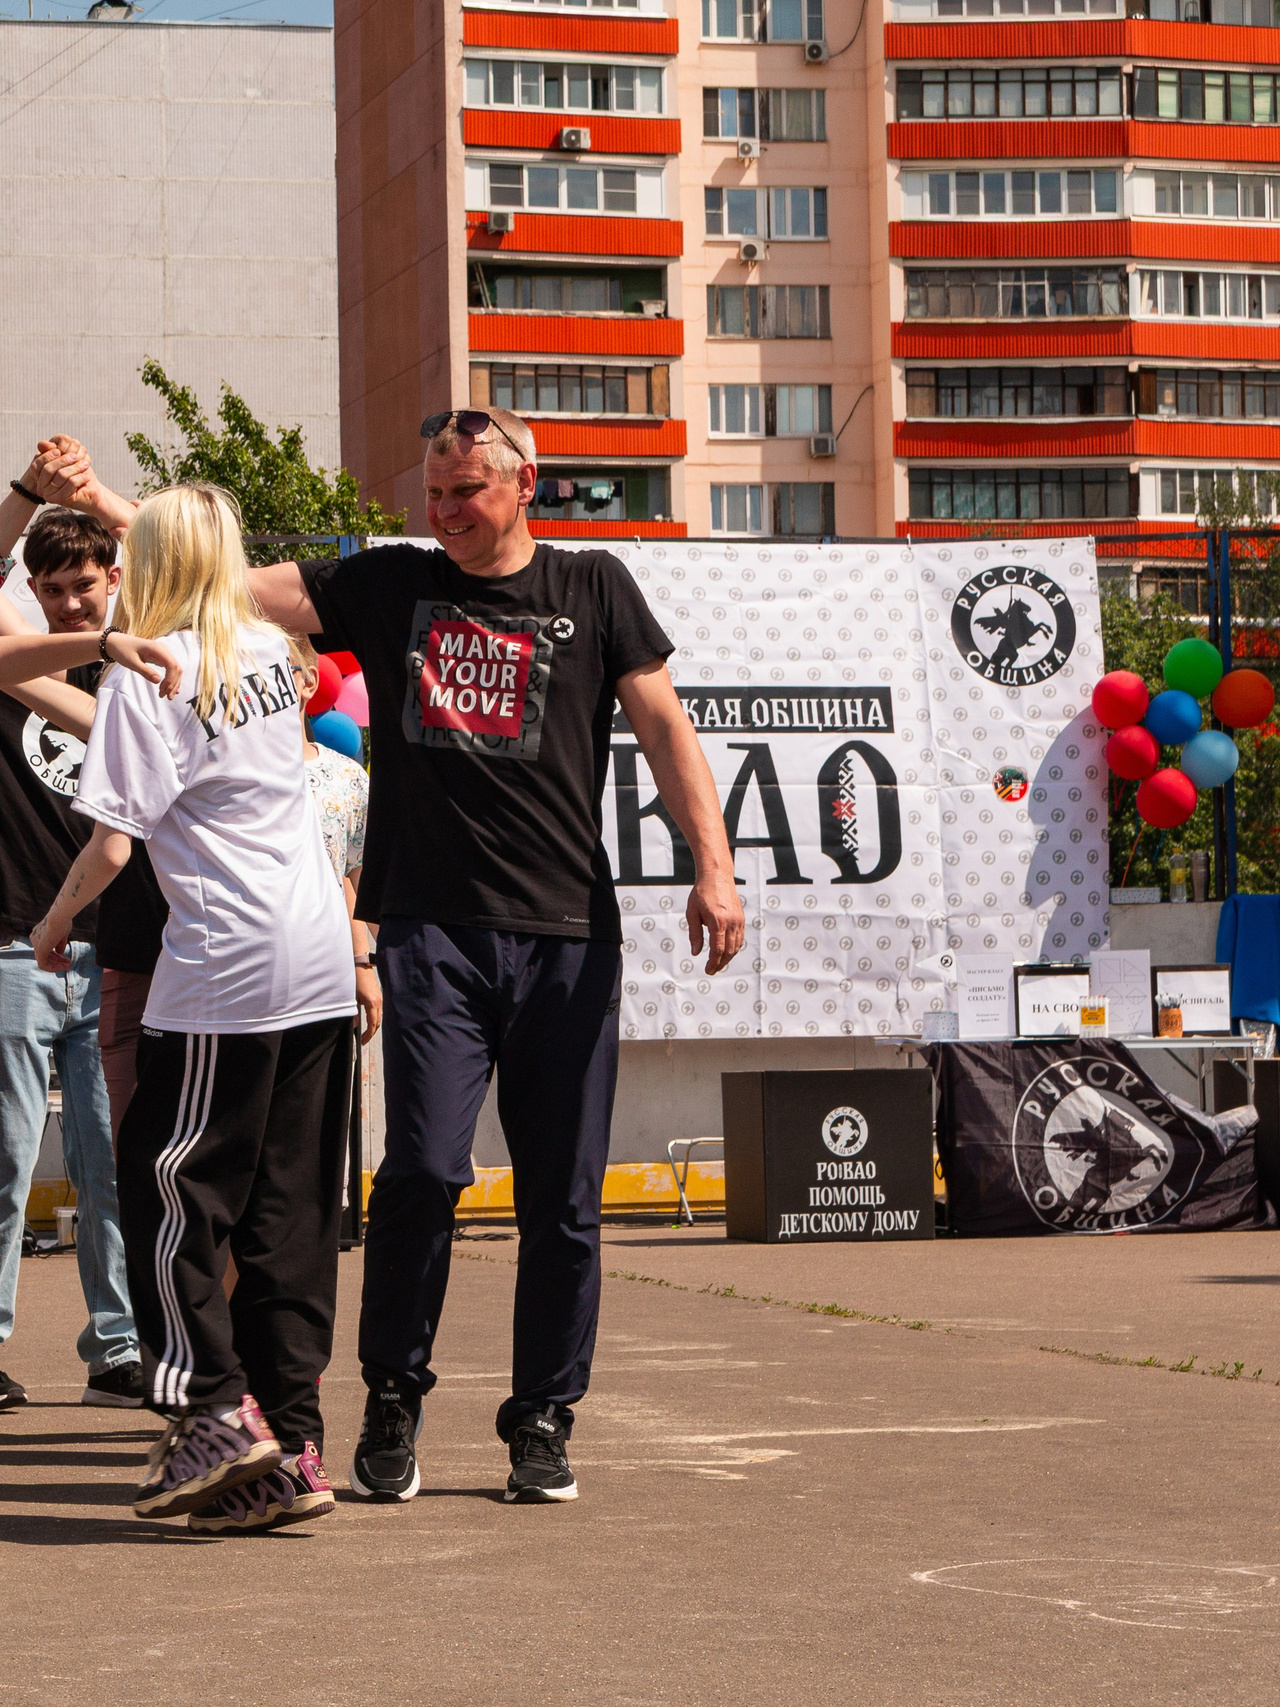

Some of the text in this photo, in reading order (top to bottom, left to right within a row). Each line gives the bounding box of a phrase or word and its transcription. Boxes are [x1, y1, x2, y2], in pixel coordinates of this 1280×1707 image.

[956, 566, 1066, 611] РУССКАЯ
[439, 632, 522, 661] MAKE
[438, 658, 518, 690] YOUR
[966, 647, 1067, 686] ОБЩИНА
[429, 684, 516, 718] MOVE
[750, 697, 888, 732] ОБЩИНА
[1032, 1003, 1052, 1014] НА
[1053, 1003, 1079, 1014] СВО
[1180, 997, 1225, 1005] ОСПИТАЛЬ
[142, 1027, 164, 1038] adidas
[1023, 1061, 1180, 1127] РУССКАЯ
[824, 1106, 865, 1125] РУССКАЯ
[826, 1140, 864, 1155] ОБЩИНА
[808, 1185, 886, 1209] ПОМОЩЬ
[1034, 1183, 1180, 1231] ОБЩИНА
[778, 1209, 920, 1239] ДЕТСКОМУ ДОМУ
